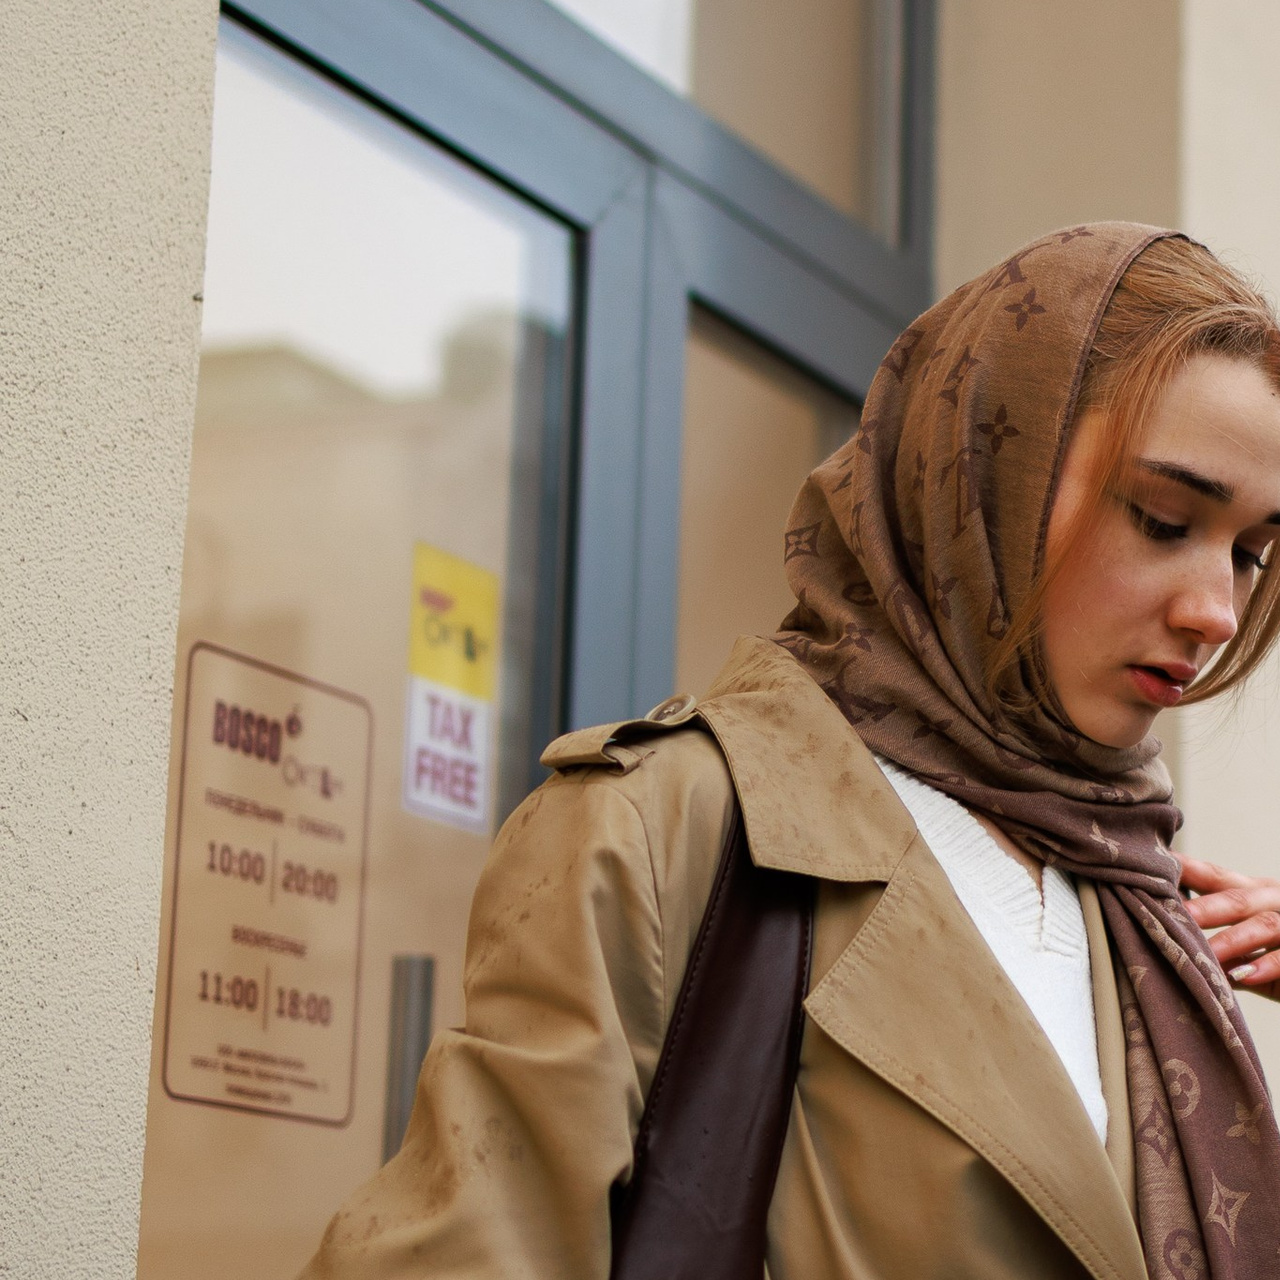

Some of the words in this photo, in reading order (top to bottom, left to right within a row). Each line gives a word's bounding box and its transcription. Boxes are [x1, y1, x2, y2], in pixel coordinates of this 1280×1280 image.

[212, 699, 283, 765] BOSCO
[426, 691, 474, 751] TAX
[415, 744, 477, 809] FREE
[206, 840, 266, 885] 10:00
[281, 861, 339, 904] 20:00
[198, 971, 260, 1012] 11:00
[275, 987, 333, 1026] 18:00
